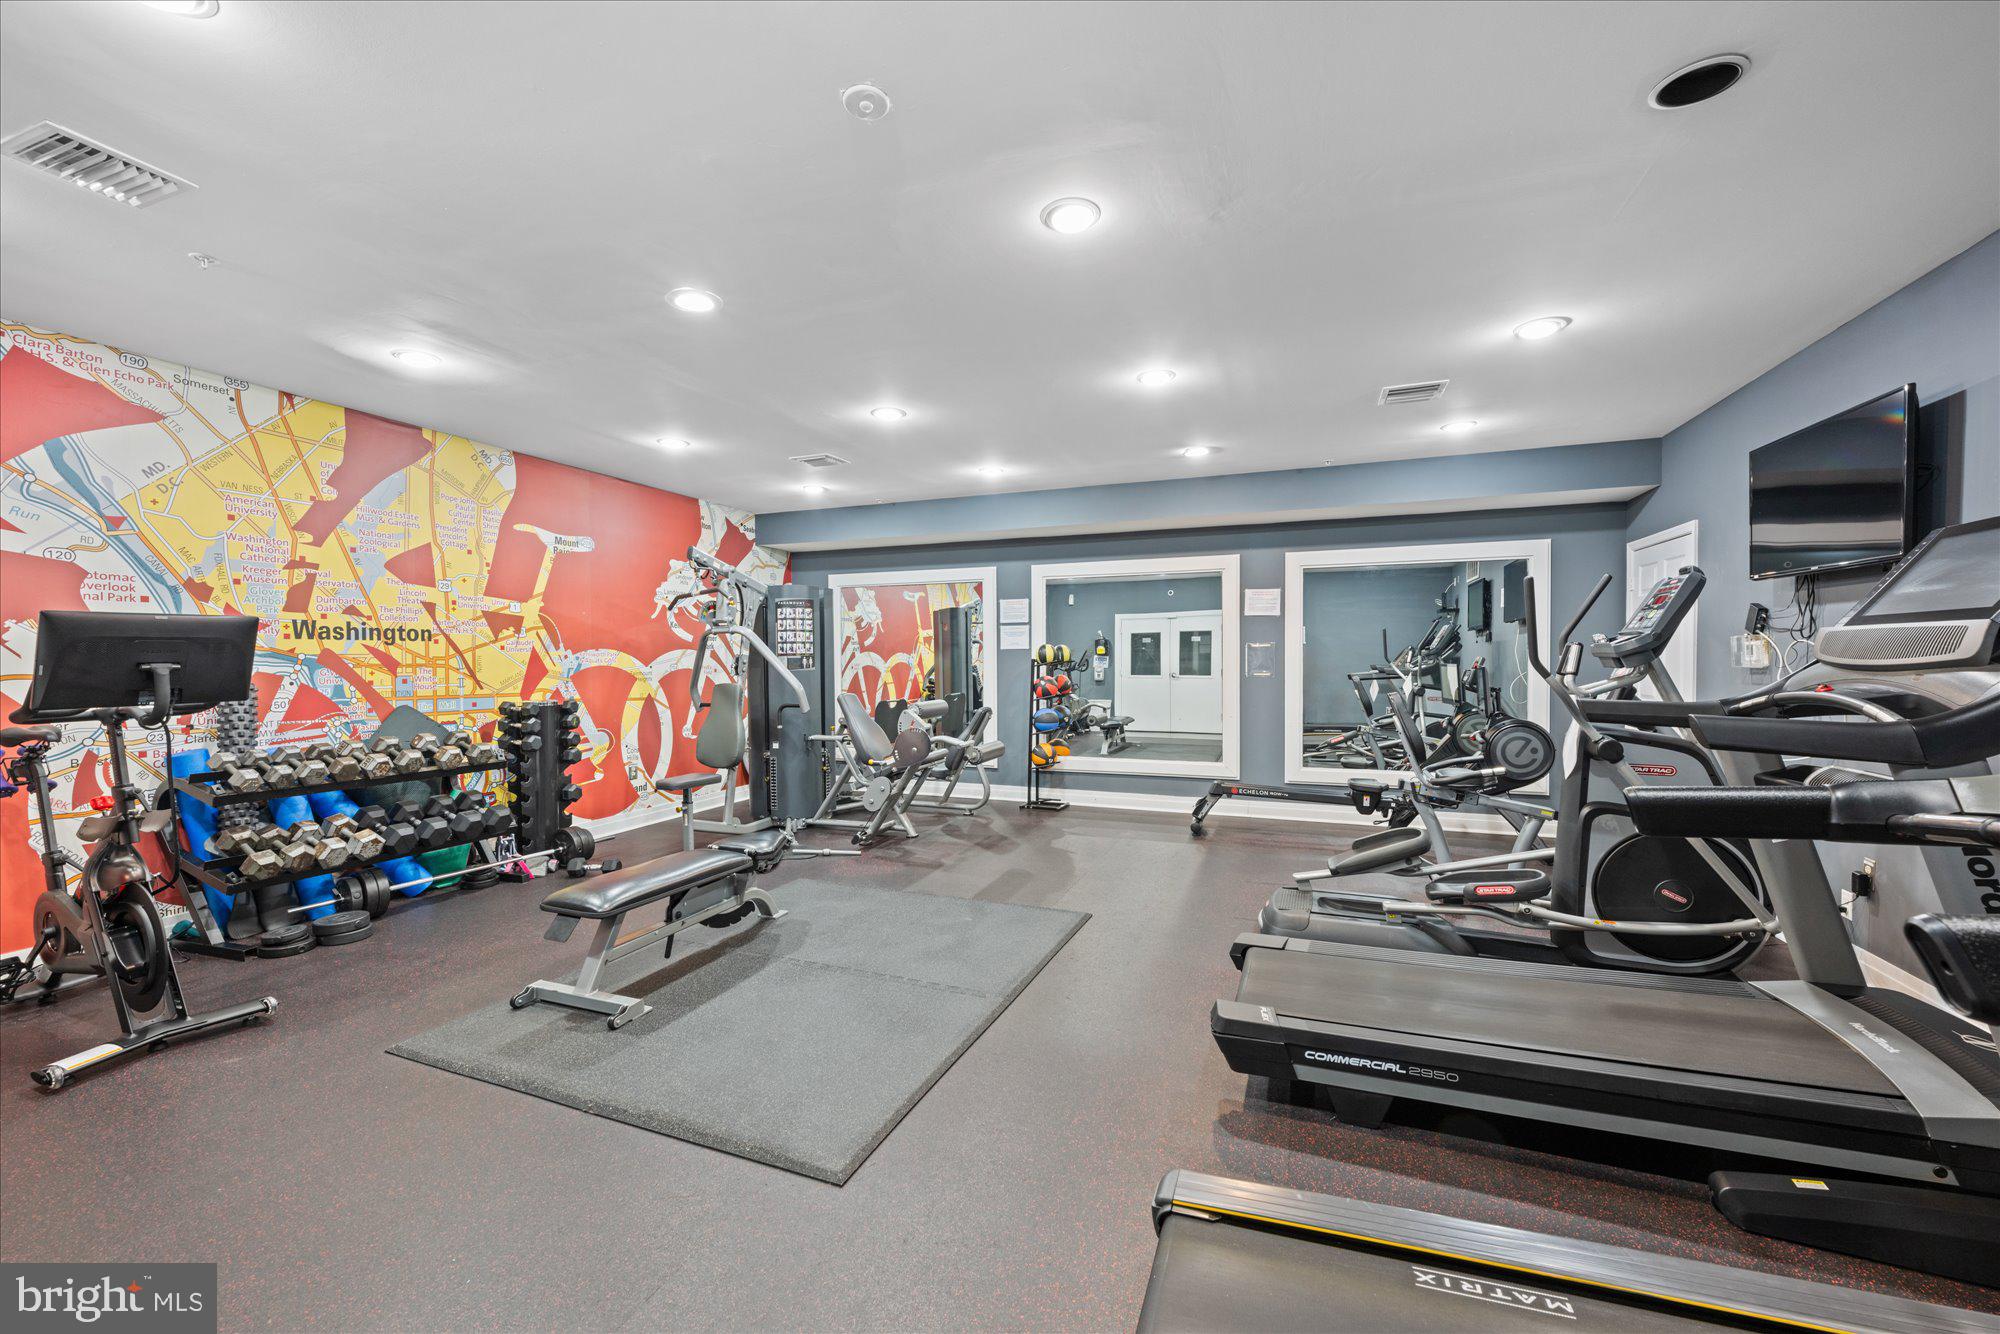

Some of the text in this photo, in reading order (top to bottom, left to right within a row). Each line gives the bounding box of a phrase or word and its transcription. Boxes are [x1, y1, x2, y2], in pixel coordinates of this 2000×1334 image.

[13, 333, 103, 364] Clara Barton
[122, 354, 145, 368] 190
[62, 356, 175, 391] & Glen Echo Park
[173, 373, 230, 396] Somerset
[226, 377, 247, 389] 355
[200, 449, 234, 472] WESTERN
[471, 453, 485, 472] D.C.
[479, 449, 493, 467] MD.
[141, 460, 171, 479] MD.
[270, 454, 298, 480] NEBRASKA
[156, 476, 184, 494] D.C.
[220, 480, 238, 490] VAN
[242, 485, 263, 494] NESS
[224, 494, 275, 509] American
[8, 505, 41, 522] Run
[225, 503, 278, 520] University
[356, 506, 419, 521] Hillwood Estate
[448, 510, 475, 519] Cultural
[387, 518, 421, 529] Gardens
[435, 522, 467, 534] President
[453, 518, 476, 527] Center
[80, 535, 94, 545] RD
[225, 532, 289, 549] Washington
[359, 529, 395, 540] National
[359, 537, 401, 549] Zoological
[441, 540, 468, 550] Cottage
[554, 536, 579, 548] Mount
[47, 550, 73, 561] 120
[178, 546, 197, 563] MAC
[246, 543, 289, 556] National
[359, 545, 378, 554] Park
[239, 552, 290, 565] Cathedral
[87, 570, 136, 582] otomac
[242, 565, 282, 577] Kreeger
[242, 574, 288, 585] Museum
[249, 586, 285, 597] Glover
[440, 582, 450, 590] 29
[107, 592, 137, 603] Park
[399, 588, 427, 598] Lincoln
[458, 594, 484, 602] Howard
[243, 596, 285, 605] Archbol
[316, 595, 367, 606] Dumbarton
[458, 601, 491, 610] University
[256, 605, 279, 614] Park
[316, 605, 339, 613] Oaks
[378, 605, 424, 616] The Phillips
[378, 613, 419, 623] Collection
[291, 619, 432, 646] Washington
[318, 676, 342, 685] Univ.
[273, 700, 287, 710] 50
[136, 770, 149, 781] RD
[1239, 788, 1269, 796] ECHELON
[1304, 1050, 1460, 1083] COMMERCIAL 2950
[1413, 1270, 1575, 1314] MATRIX
